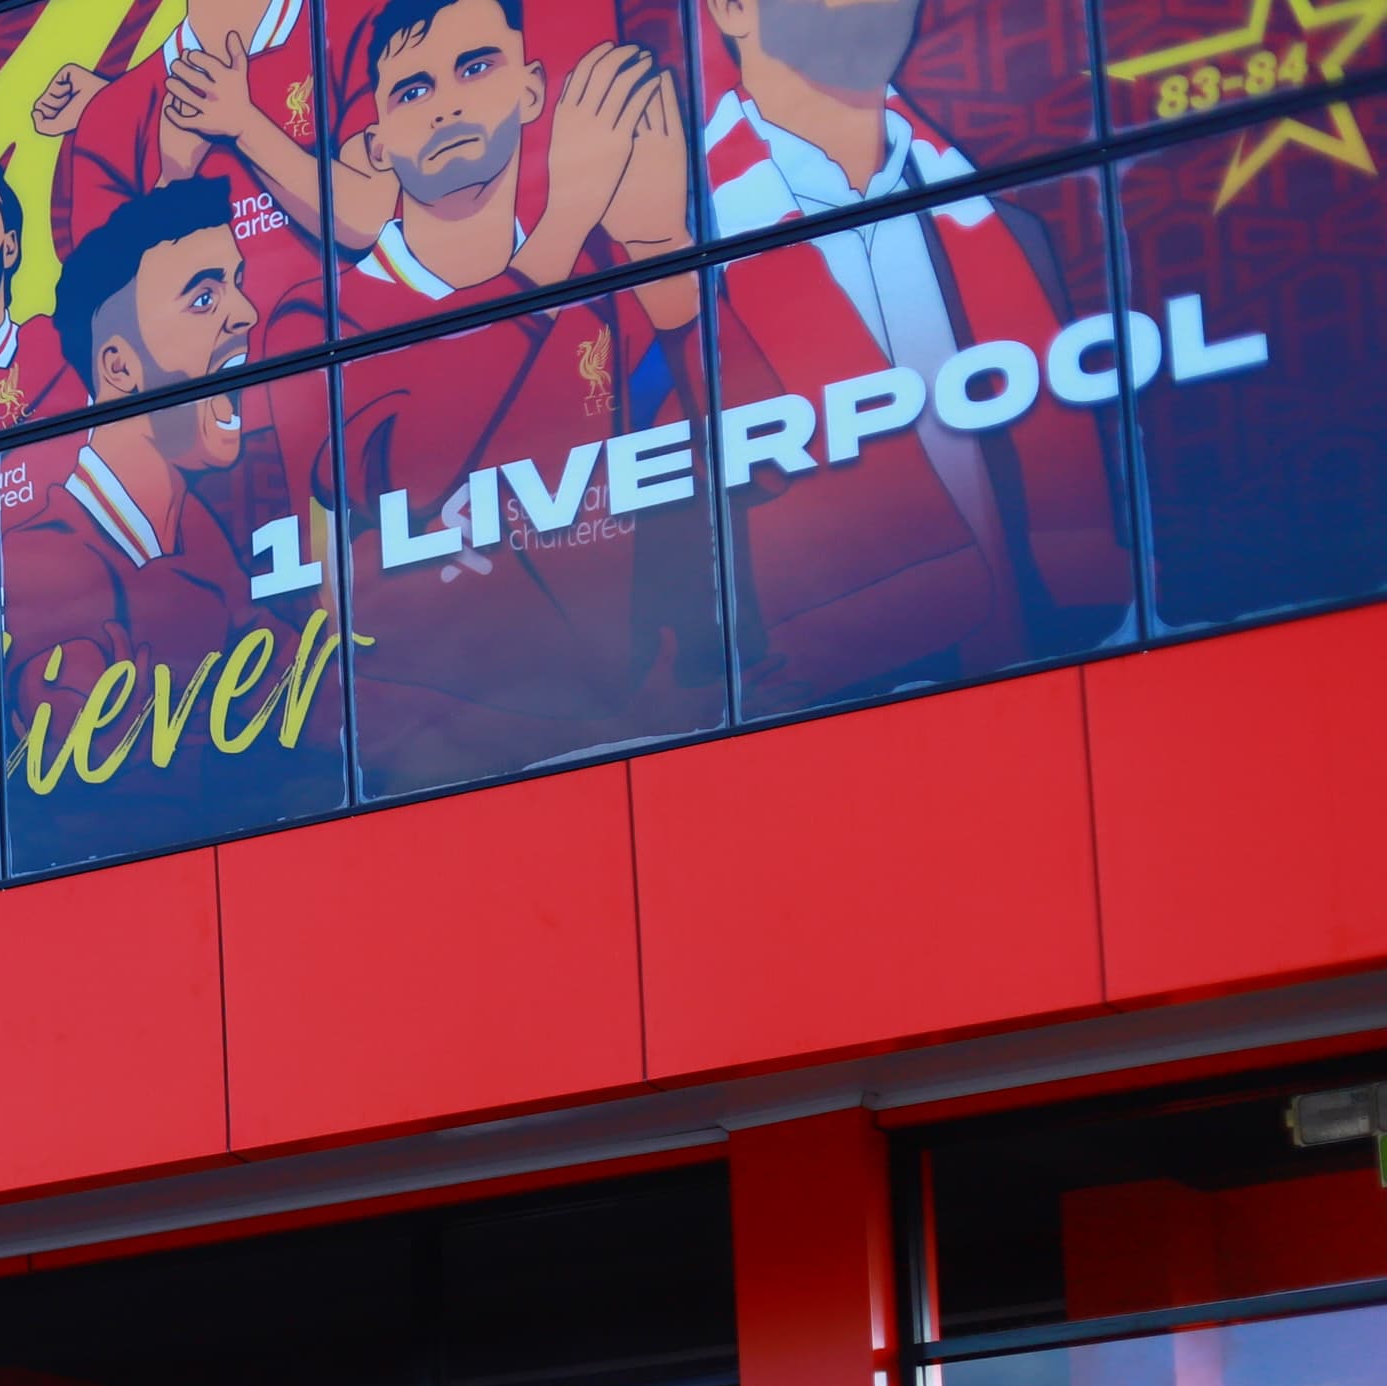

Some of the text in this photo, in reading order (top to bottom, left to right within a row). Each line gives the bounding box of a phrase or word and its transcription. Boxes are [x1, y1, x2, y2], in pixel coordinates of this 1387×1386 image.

[1156, 42, 1309, 120] 83-84
[249, 292, 1269, 600] 1 LIVERPOOL
